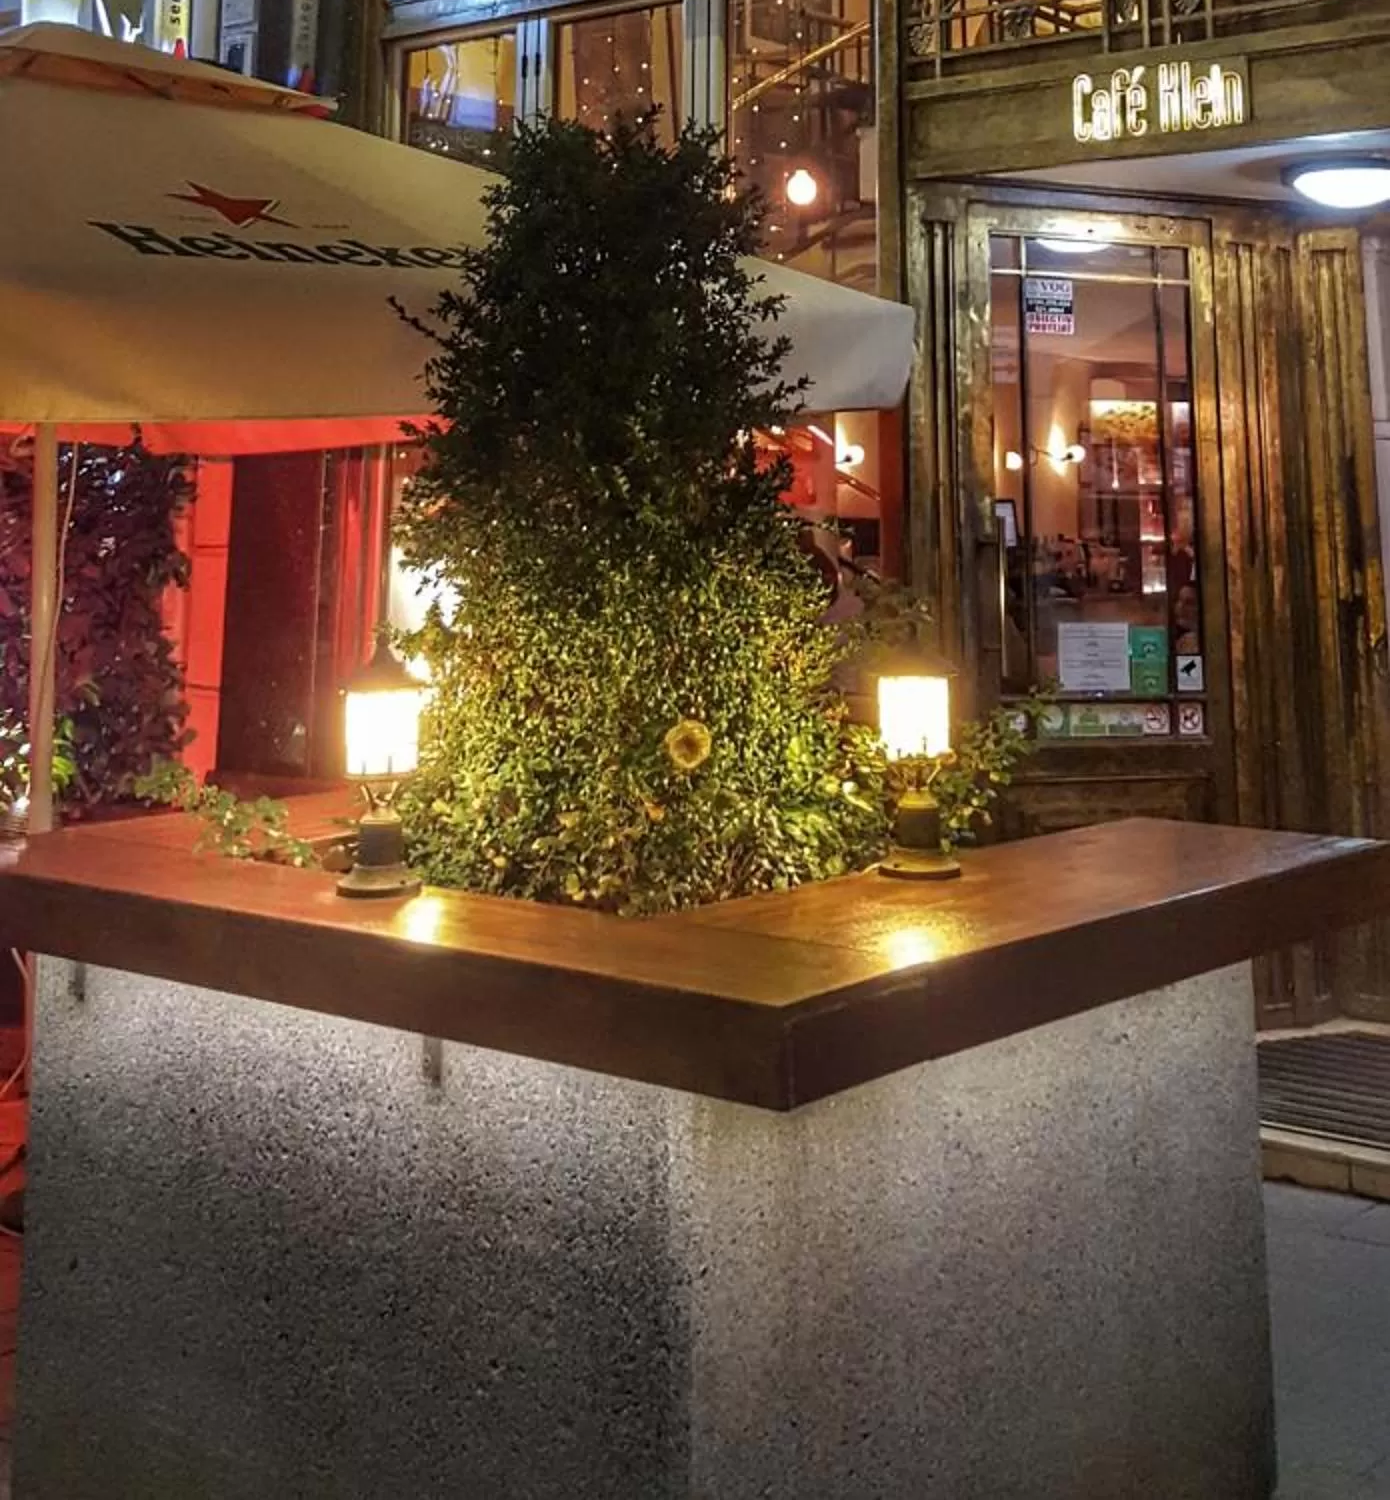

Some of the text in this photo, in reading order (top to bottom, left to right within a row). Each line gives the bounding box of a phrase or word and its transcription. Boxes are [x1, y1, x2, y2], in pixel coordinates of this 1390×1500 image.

[1073, 62, 1244, 142] Café Klein
[87, 220, 476, 269] Heineke
